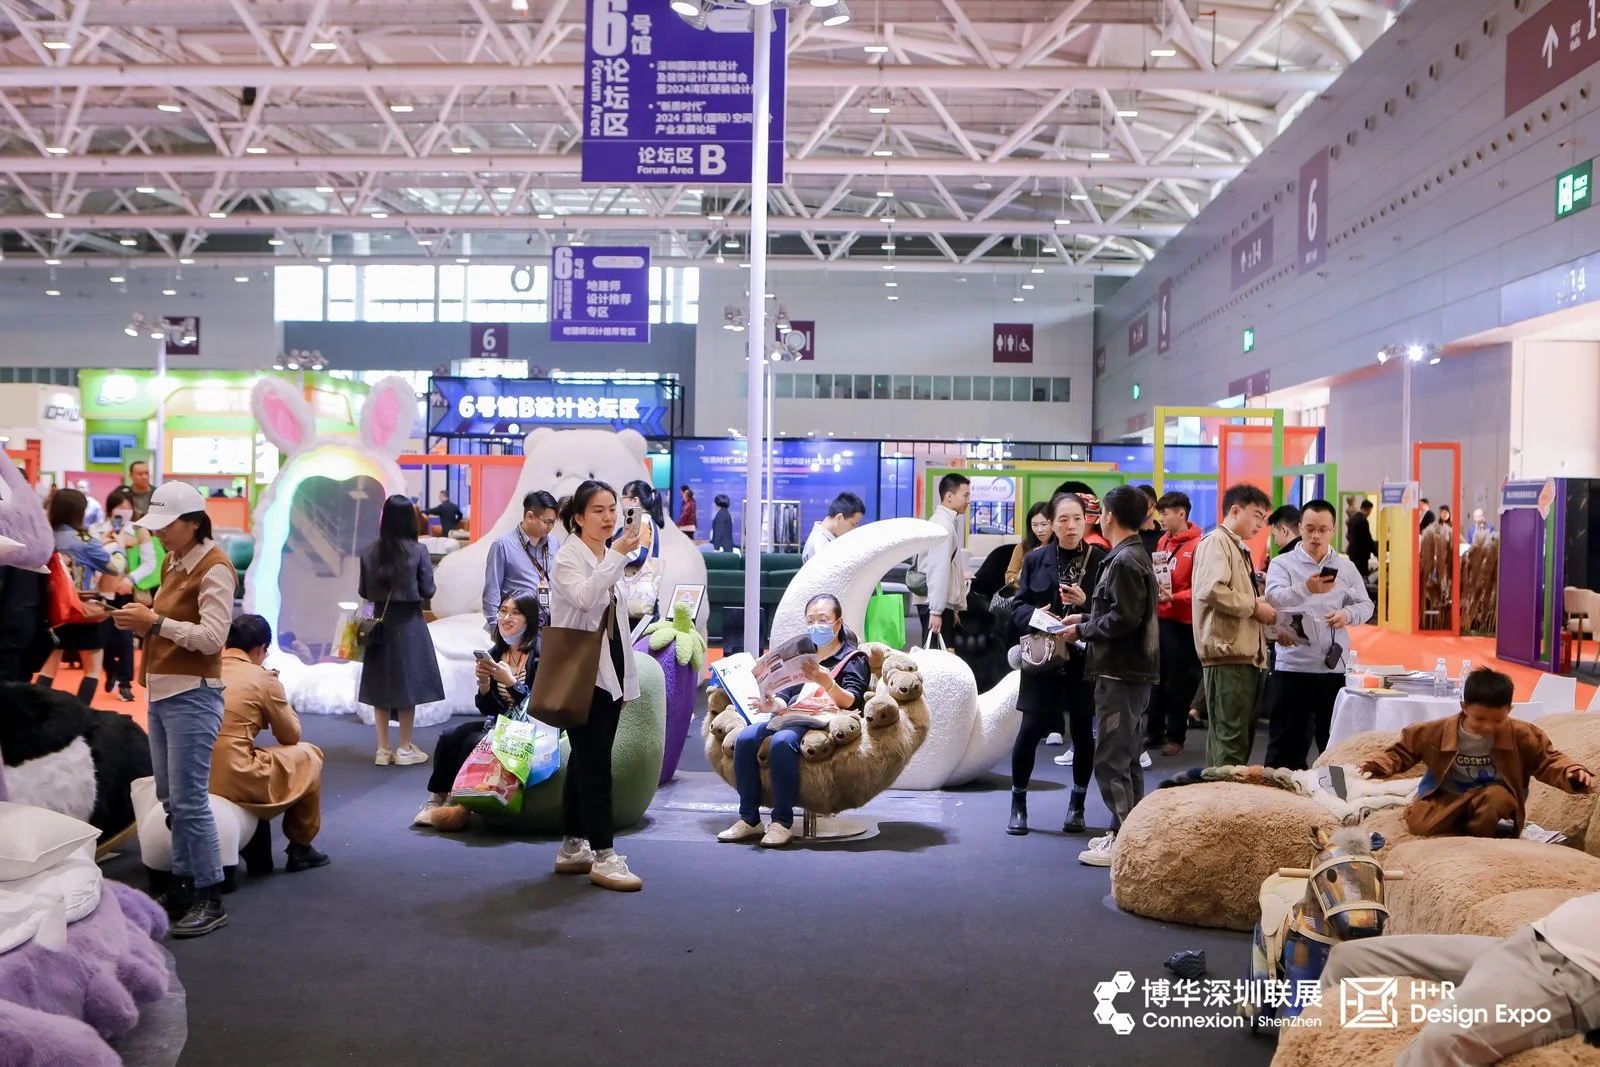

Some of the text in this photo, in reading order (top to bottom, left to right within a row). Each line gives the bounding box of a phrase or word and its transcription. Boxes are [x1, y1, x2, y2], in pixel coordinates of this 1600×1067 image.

[592, 0, 652, 56] 6 号馆
[590, 60, 604, 136] Forum Area
[603, 58, 630, 136] 论坛区
[655, 113, 680, 123] 2024
[655, 124, 717, 135] 产业发展论坛
[637, 165, 694, 175] Forum Area
[638, 144, 727, 175] 论坛区 B
[1307, 178, 1318, 242] 6
[555, 247, 573, 280] 6
[586, 293, 632, 305] 设计推荐
[586, 306, 609, 318] 专区
[482, 328, 497, 351] 6
